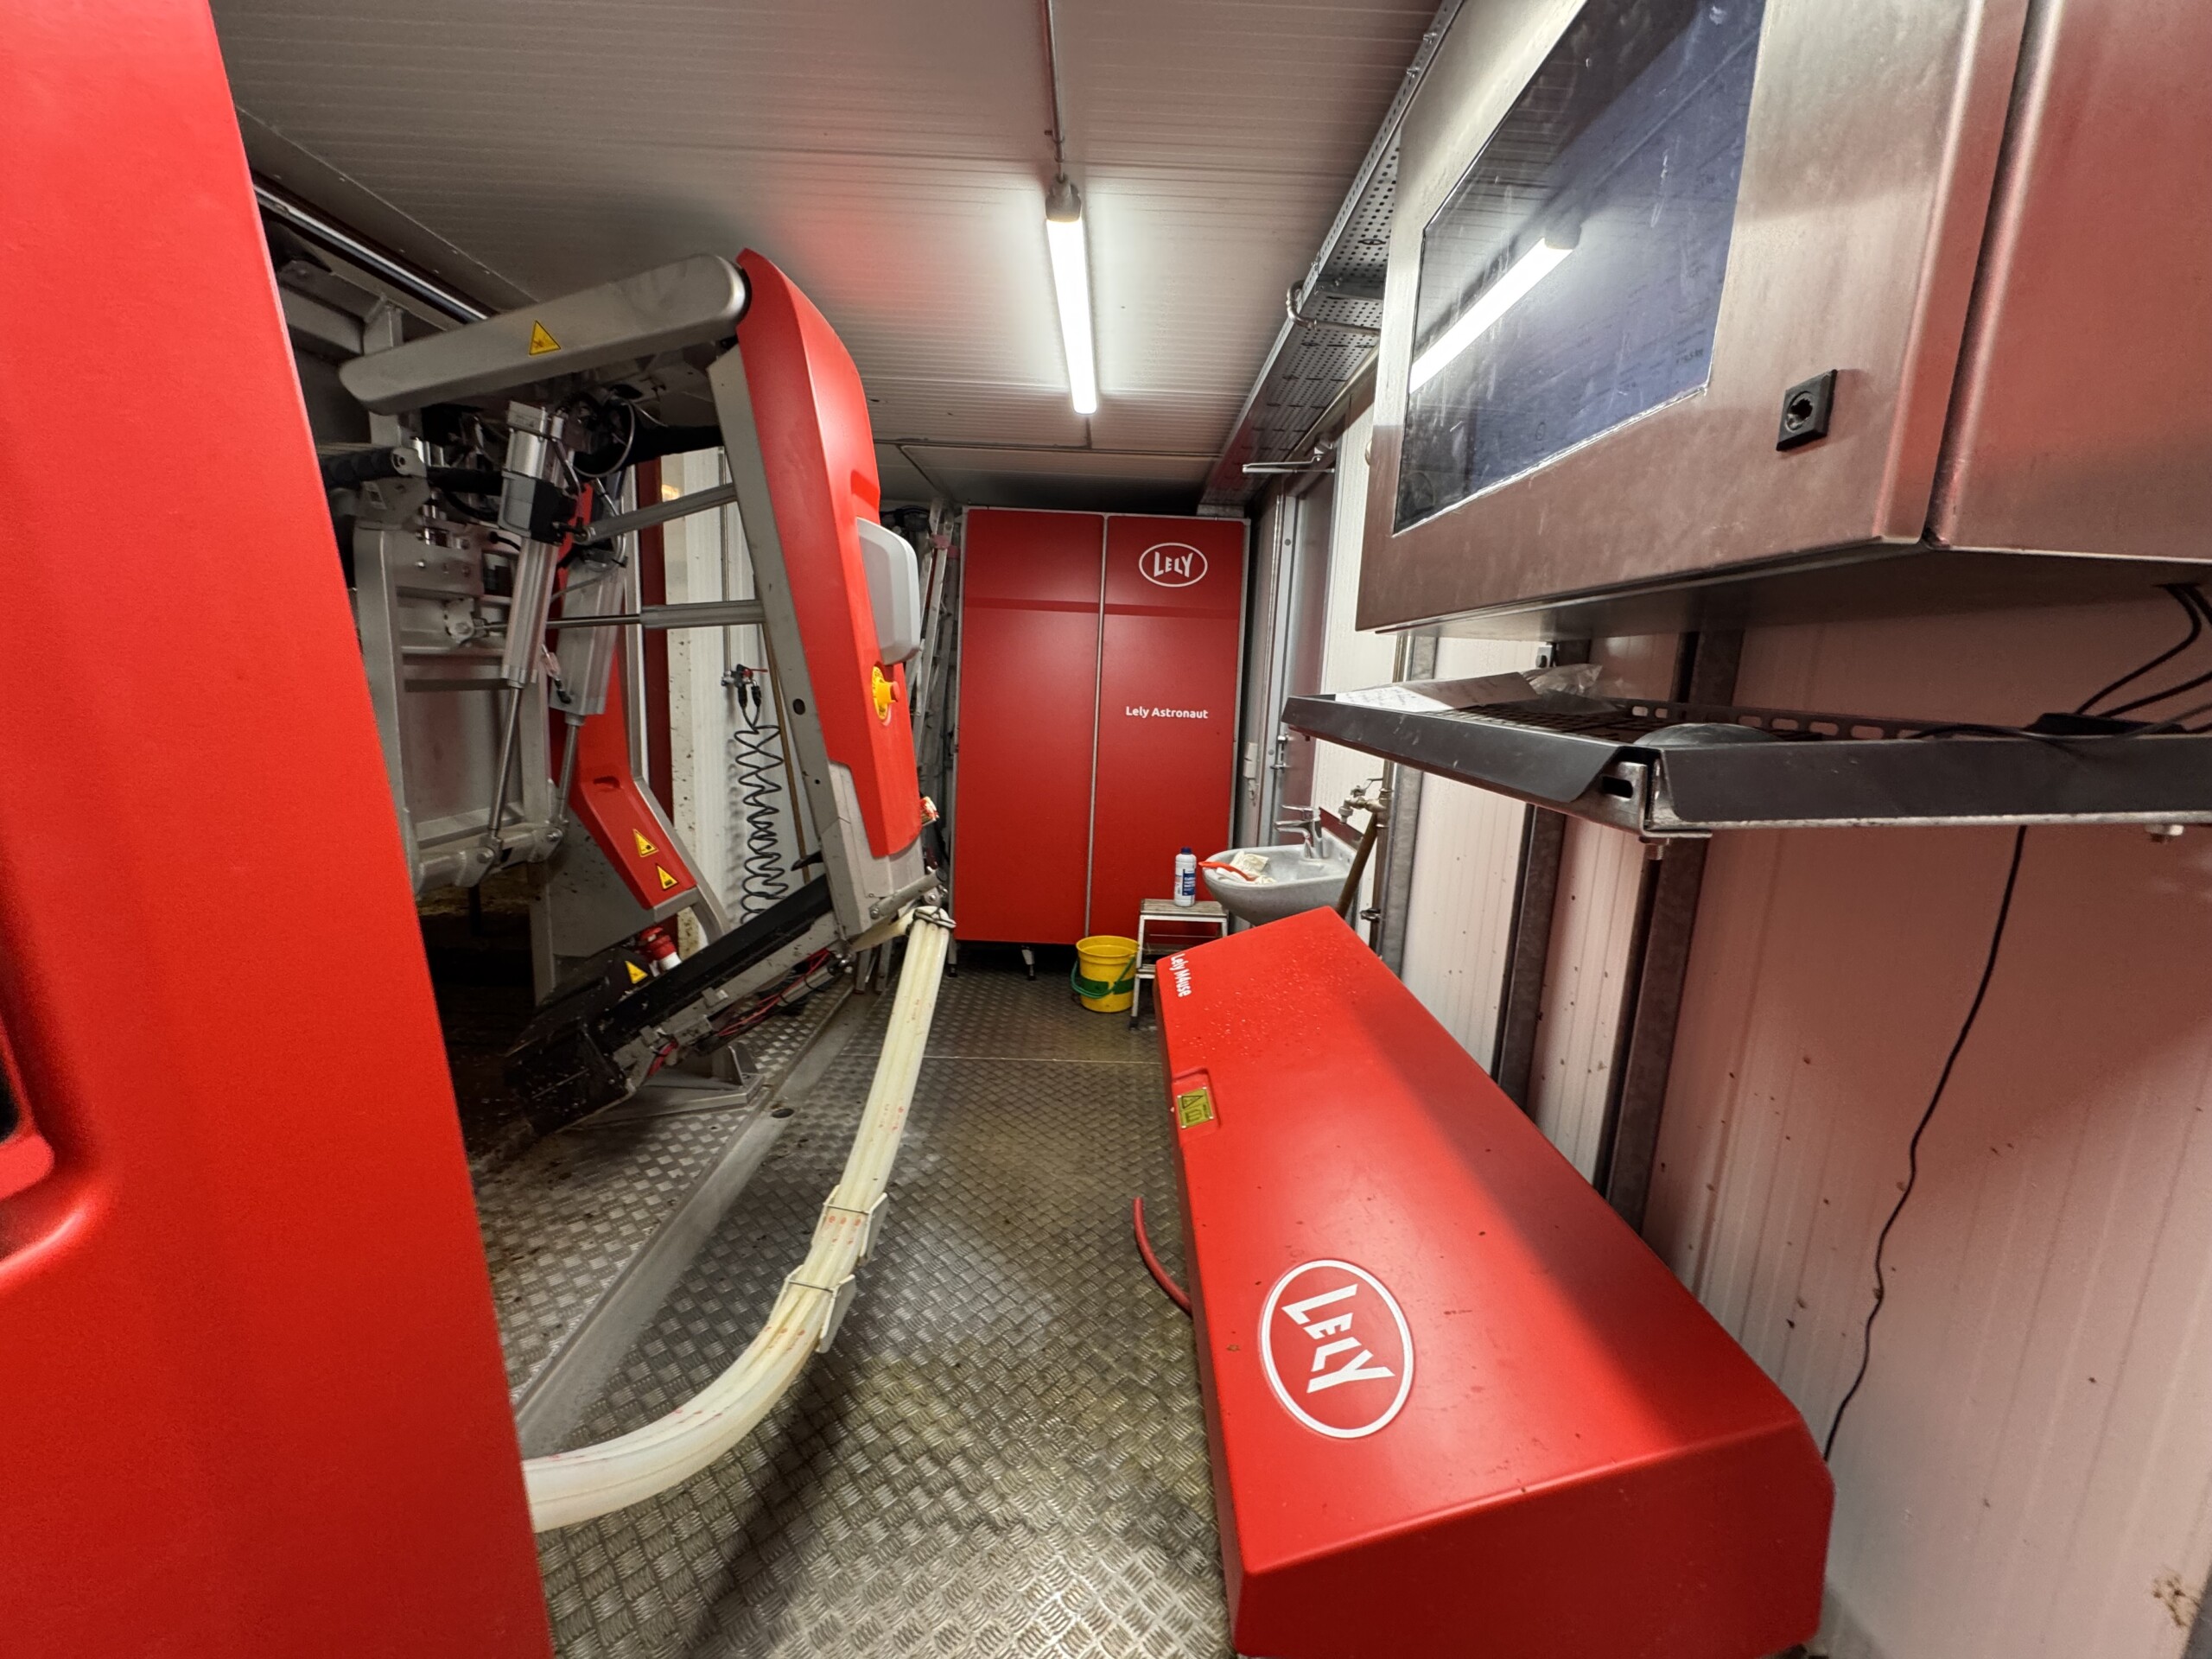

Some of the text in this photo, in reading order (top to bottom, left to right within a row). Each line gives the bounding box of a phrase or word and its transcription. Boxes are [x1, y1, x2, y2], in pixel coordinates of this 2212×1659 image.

[1154, 551, 1193, 577] LELY
[1126, 706, 1209, 719] Lely Astronaut
[1169, 953, 1189, 970] Lely
[1281, 1283, 1395, 1394] LELY
